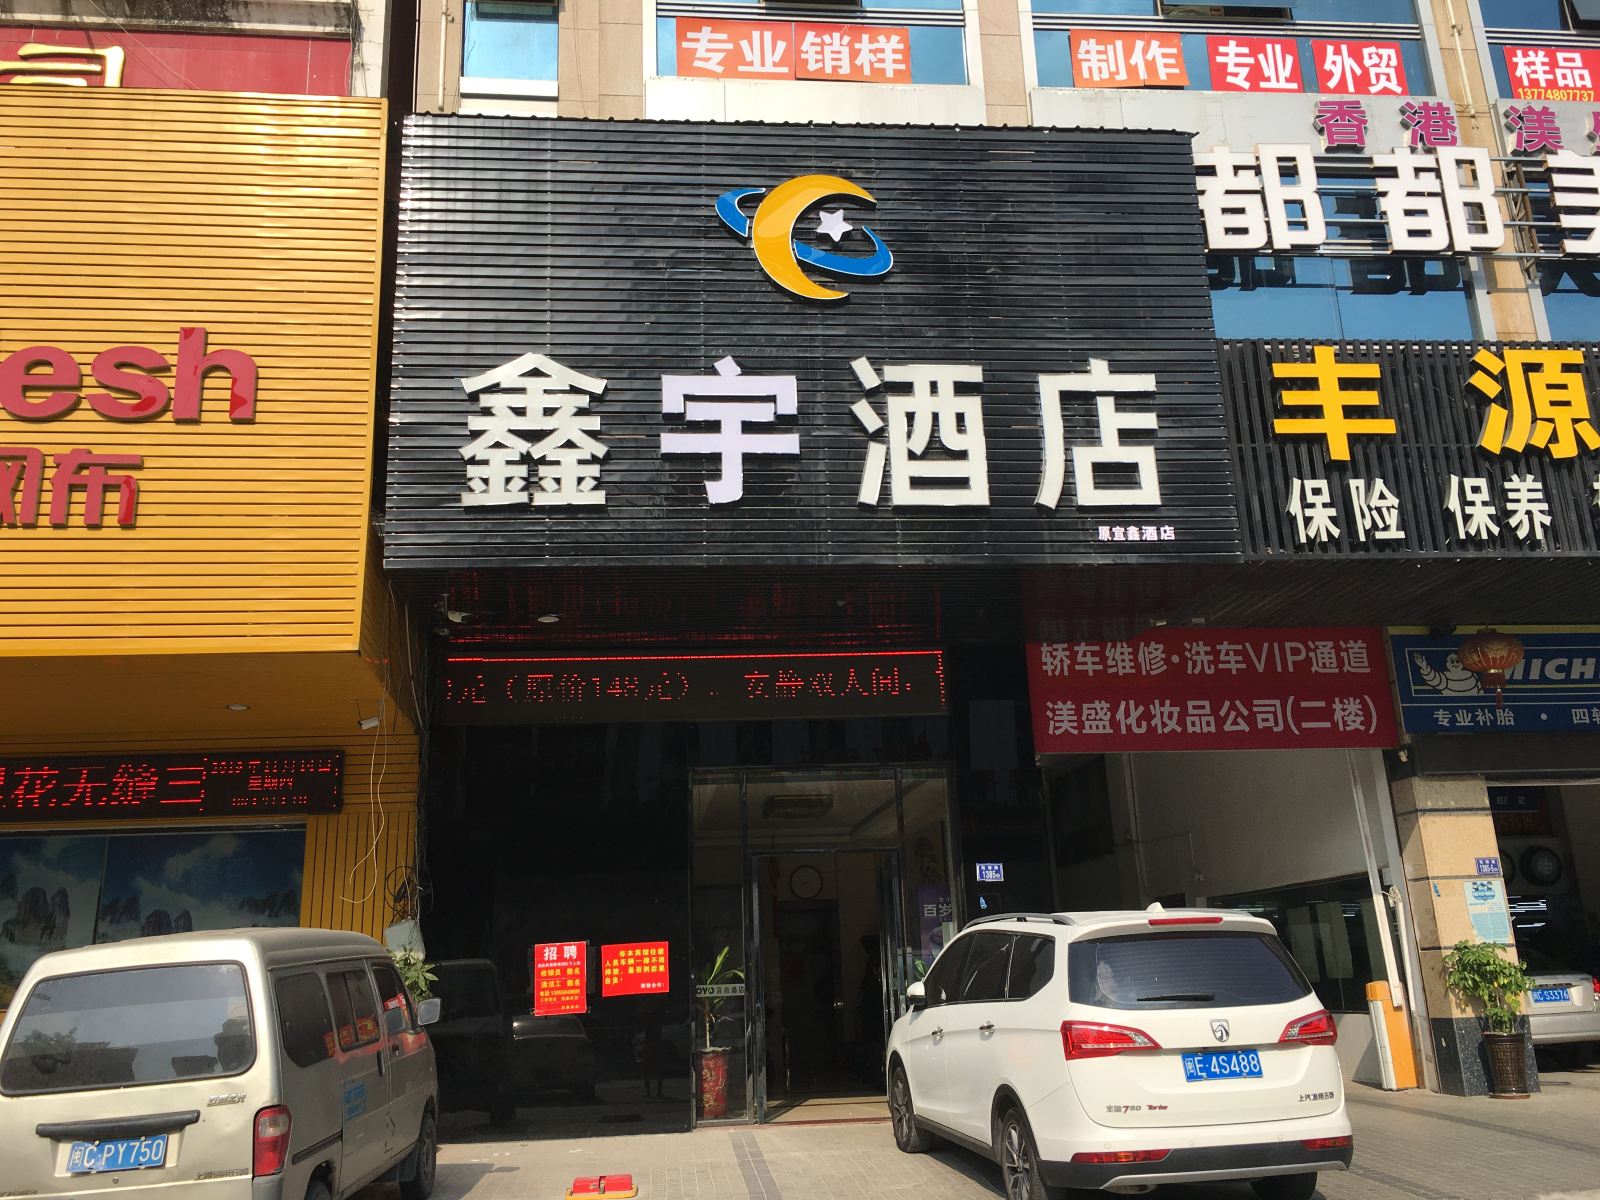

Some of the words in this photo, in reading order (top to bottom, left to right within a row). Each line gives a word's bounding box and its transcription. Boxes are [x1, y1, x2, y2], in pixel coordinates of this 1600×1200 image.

[681, 26, 789, 74] 专业
[800, 30, 906, 78] 销样
[1077, 37, 1180, 83] 制作
[1215, 40, 1298, 91] 专业
[1323, 42, 1403, 95] 外贸
[1512, 49, 1593, 88] 样品
[1518, 88, 1594, 102] 13774807737
[1271, 345, 1600, 460] 丰源
[460, 353, 1162, 508] 鑫宇酒店
[1286, 477, 1405, 543] 保险
[1445, 473, 1552, 540] 保养
[1098, 525, 1175, 541] 原宜鑫酒店
[1504, 657, 1600, 681] MICH
[1045, 694, 1377, 735] 渼盛化妆品公司(二楼)
[1433, 708, 1515, 726] 专业补胎
[544, 945, 577, 961] 招聘
